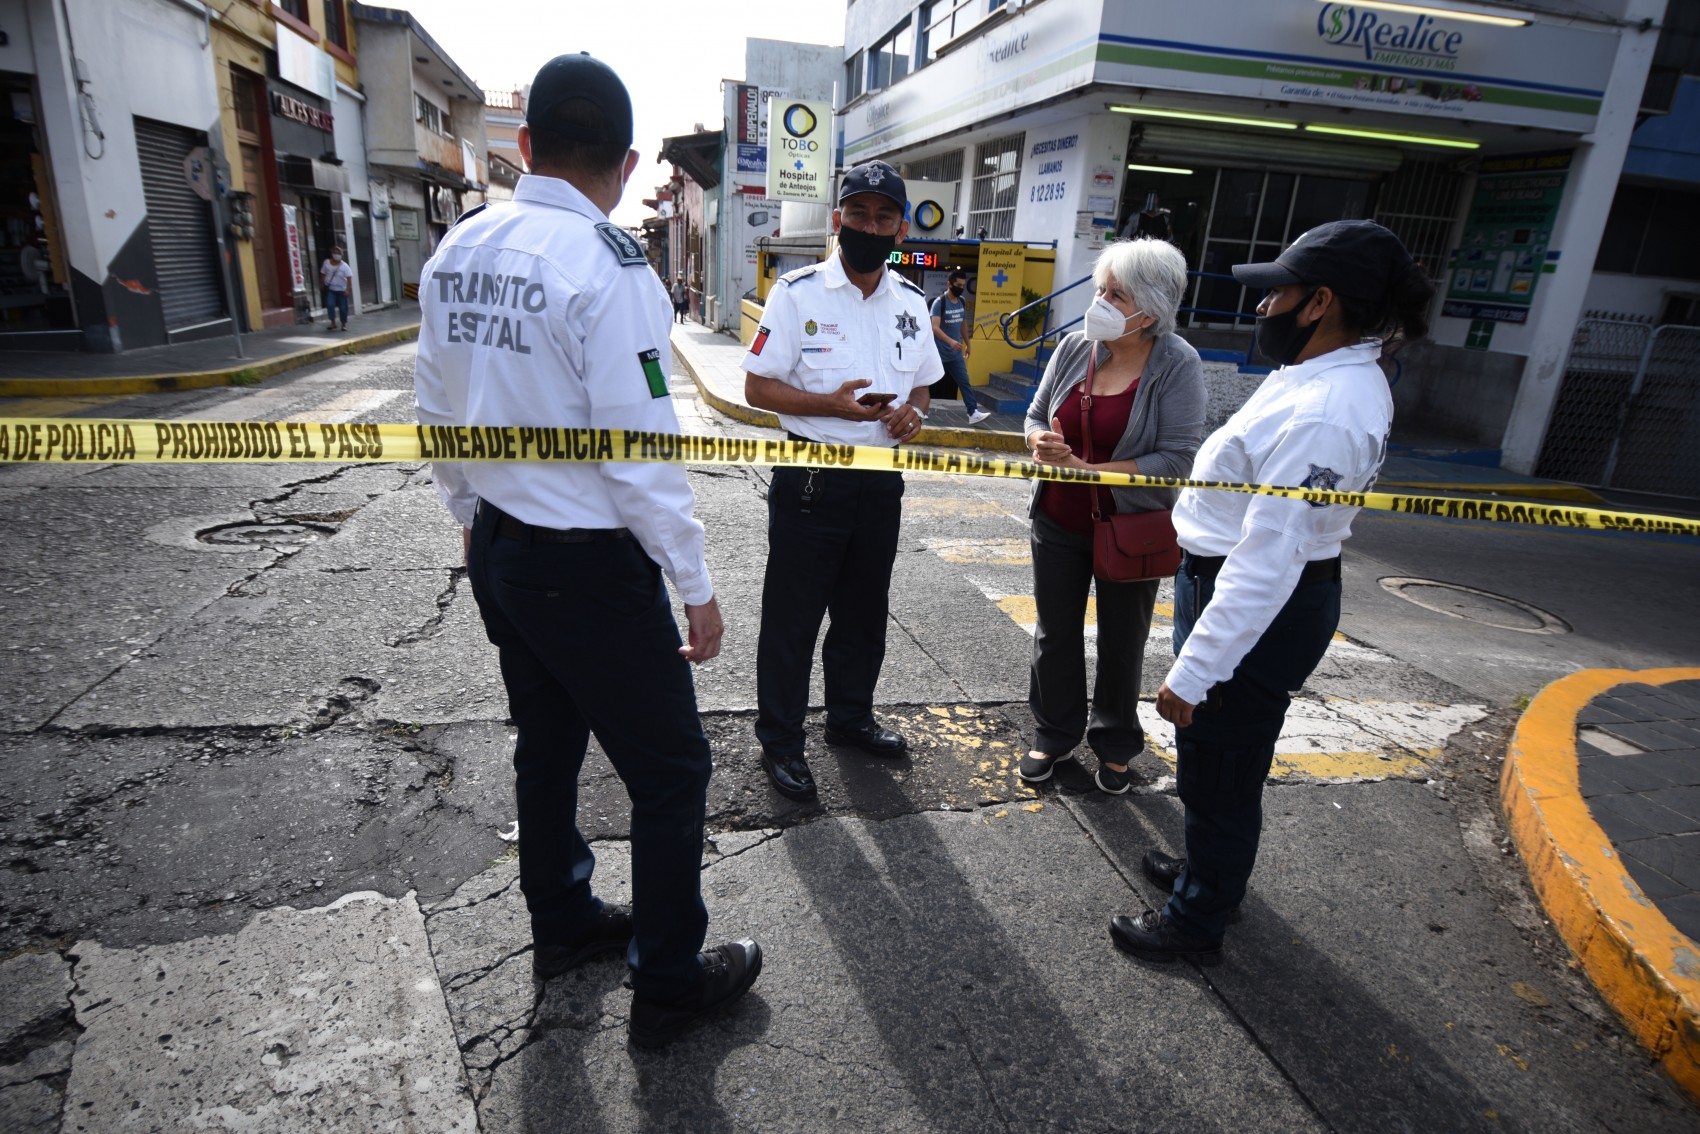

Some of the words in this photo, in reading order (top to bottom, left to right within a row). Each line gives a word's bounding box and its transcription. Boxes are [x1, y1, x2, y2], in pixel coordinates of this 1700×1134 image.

[1353, 12, 1463, 60] Realice
[781, 137, 818, 152] TOBO
[779, 169, 817, 182] Hospital
[788, 182, 816, 192] Anteojos
[982, 247, 1012, 257] Hospital
[1013, 248, 1023, 256] de
[986, 261, 1016, 270] Anteojos
[432, 271, 547, 313] TRANSITO
[13, 424, 42, 461] DE
[45, 423, 136, 461] POLICIA
[155, 422, 283, 459] PROHIBIDO
[289, 422, 317, 459] EL
[322, 423, 384, 459] PASO
[417, 425, 486, 458] LINEA
[519, 427, 613, 460] POLICIA
[623, 430, 757, 463] PROHIBIDO
